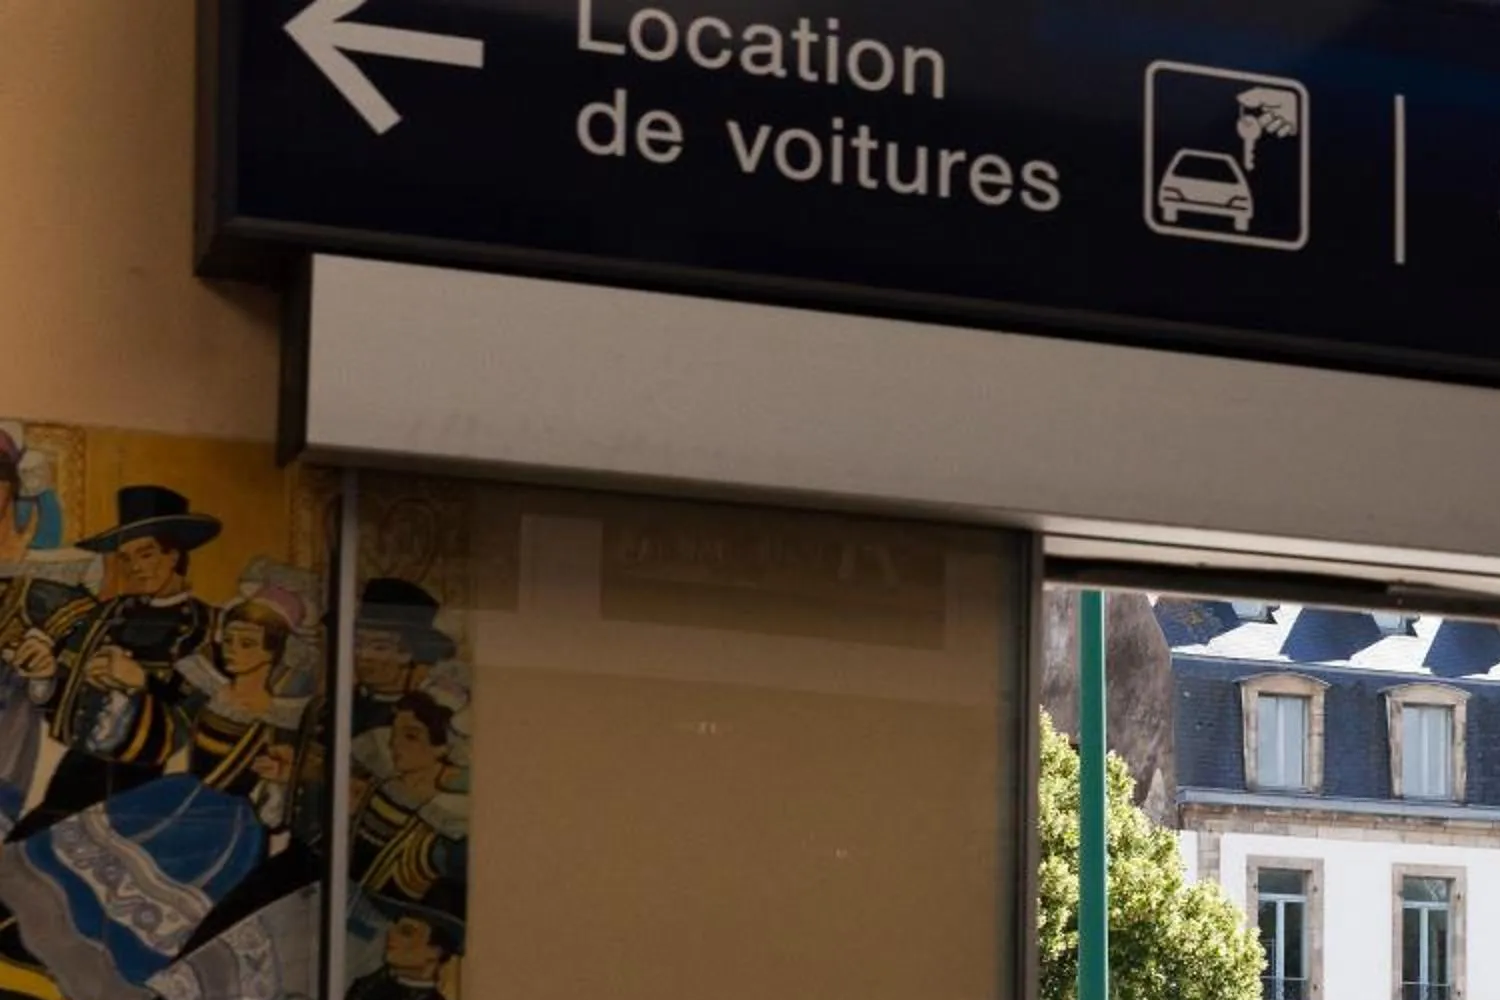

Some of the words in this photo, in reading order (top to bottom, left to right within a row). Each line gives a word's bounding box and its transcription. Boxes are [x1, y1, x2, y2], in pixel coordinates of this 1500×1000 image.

[578, 0, 945, 98] Location
[577, 90, 684, 163] de
[727, 118, 1061, 212] voitures
